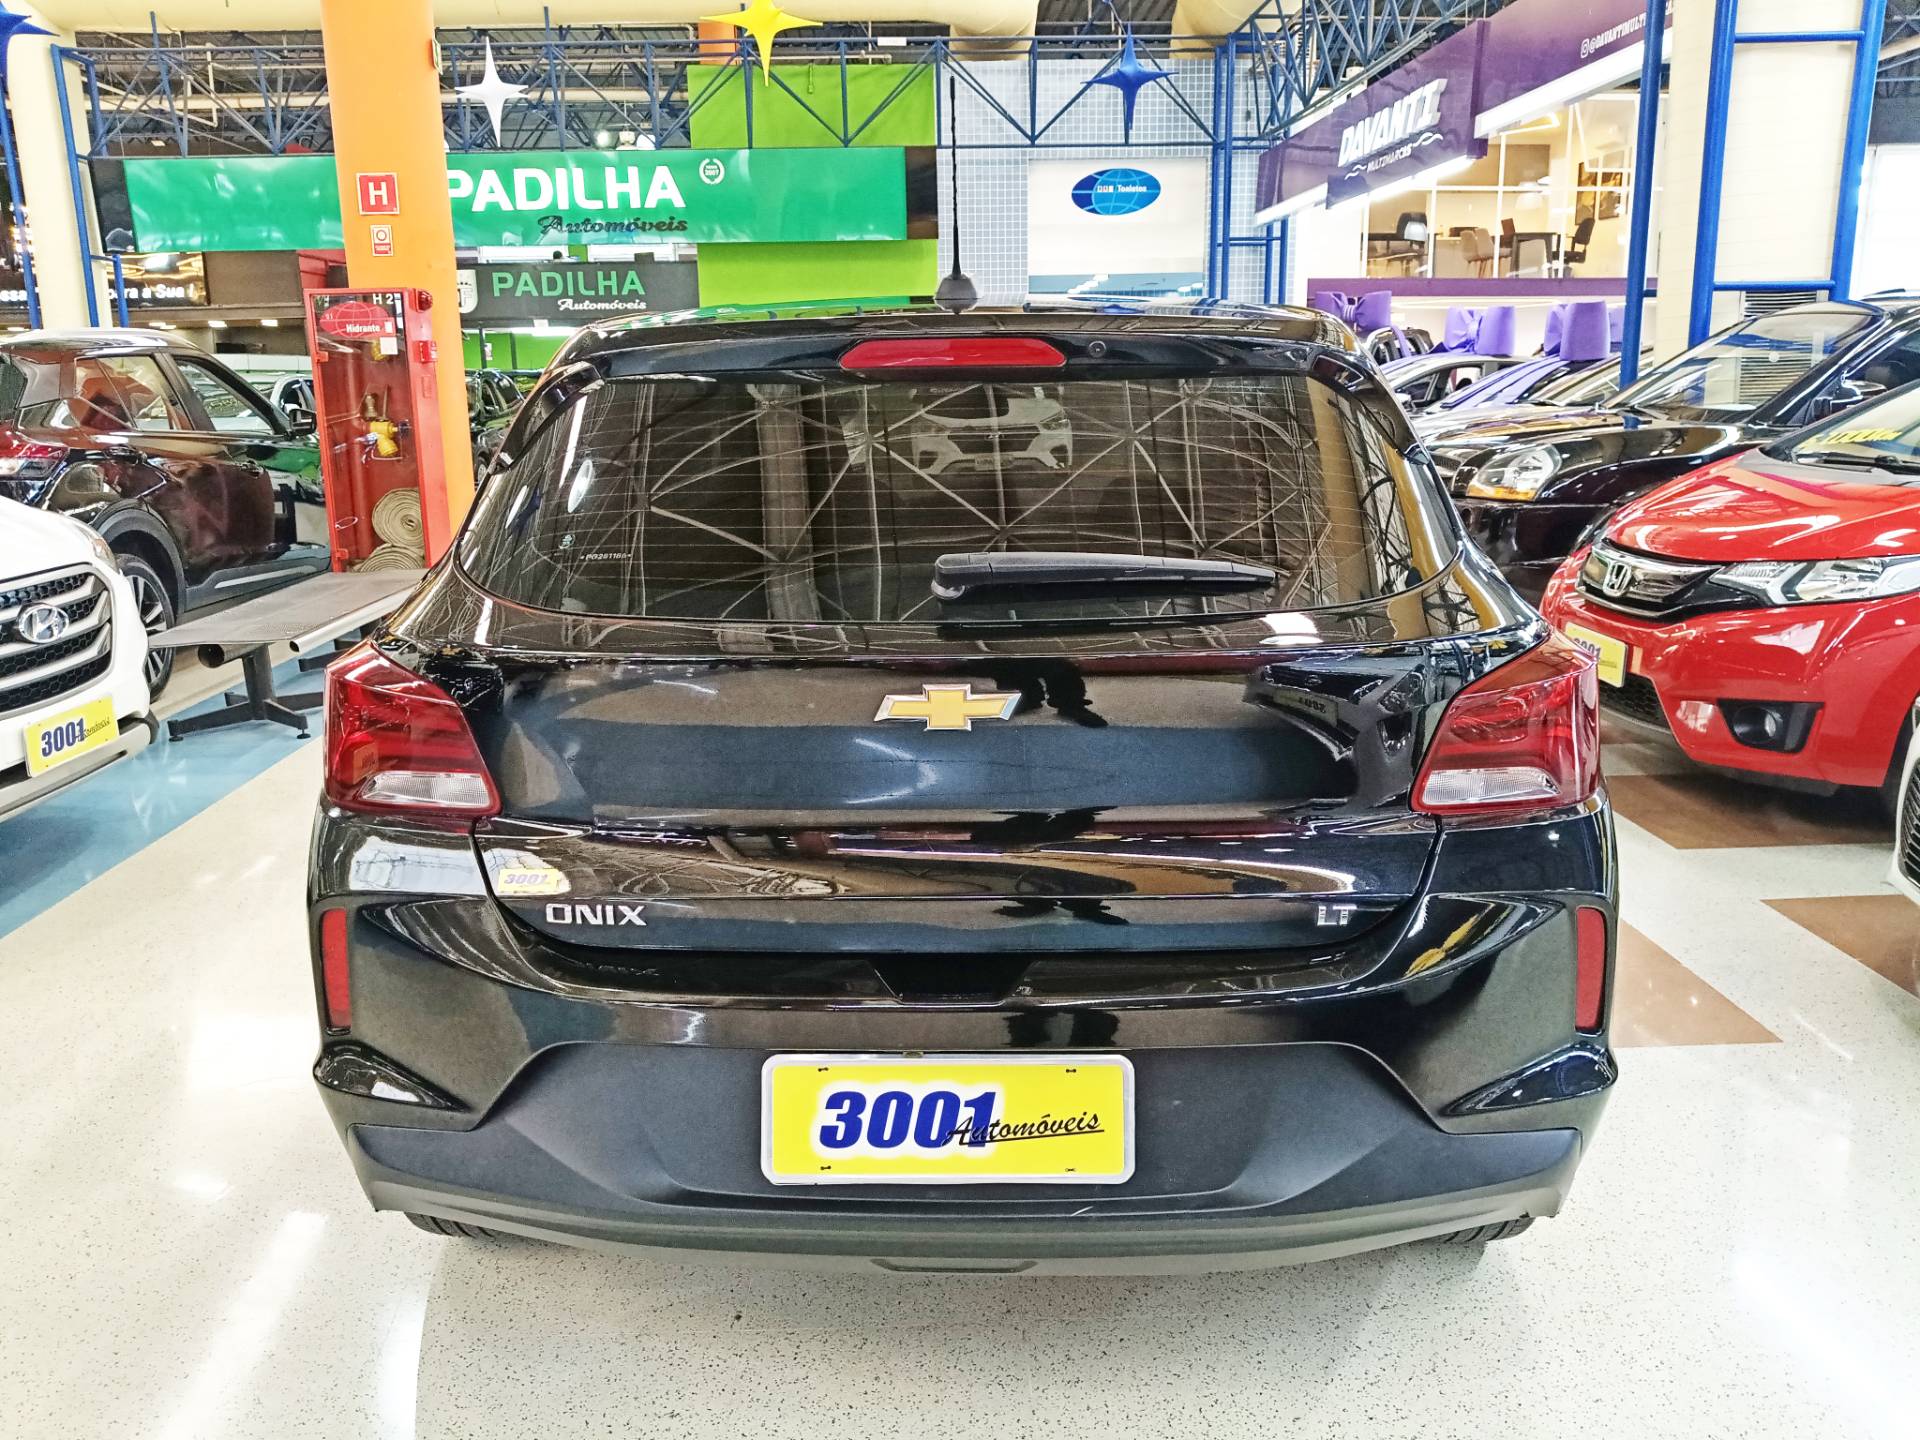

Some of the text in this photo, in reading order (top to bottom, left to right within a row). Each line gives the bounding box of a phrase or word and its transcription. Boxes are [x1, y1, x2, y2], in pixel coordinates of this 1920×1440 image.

[1338, 78, 1448, 167] DAVANTI
[368, 181, 388, 206] H
[447, 165, 686, 212] PADILHA
[538, 215, 688, 234] Automóveis
[492, 270, 646, 297] PADILHA
[558, 298, 647, 311] Automóveis
[346, 323, 380, 333] Hidrante
[41, 717, 85, 757] 3001
[545, 903, 647, 926] ONIX
[1317, 904, 1358, 926] LT
[819, 1090, 1103, 1149] 3001 Automóveis
